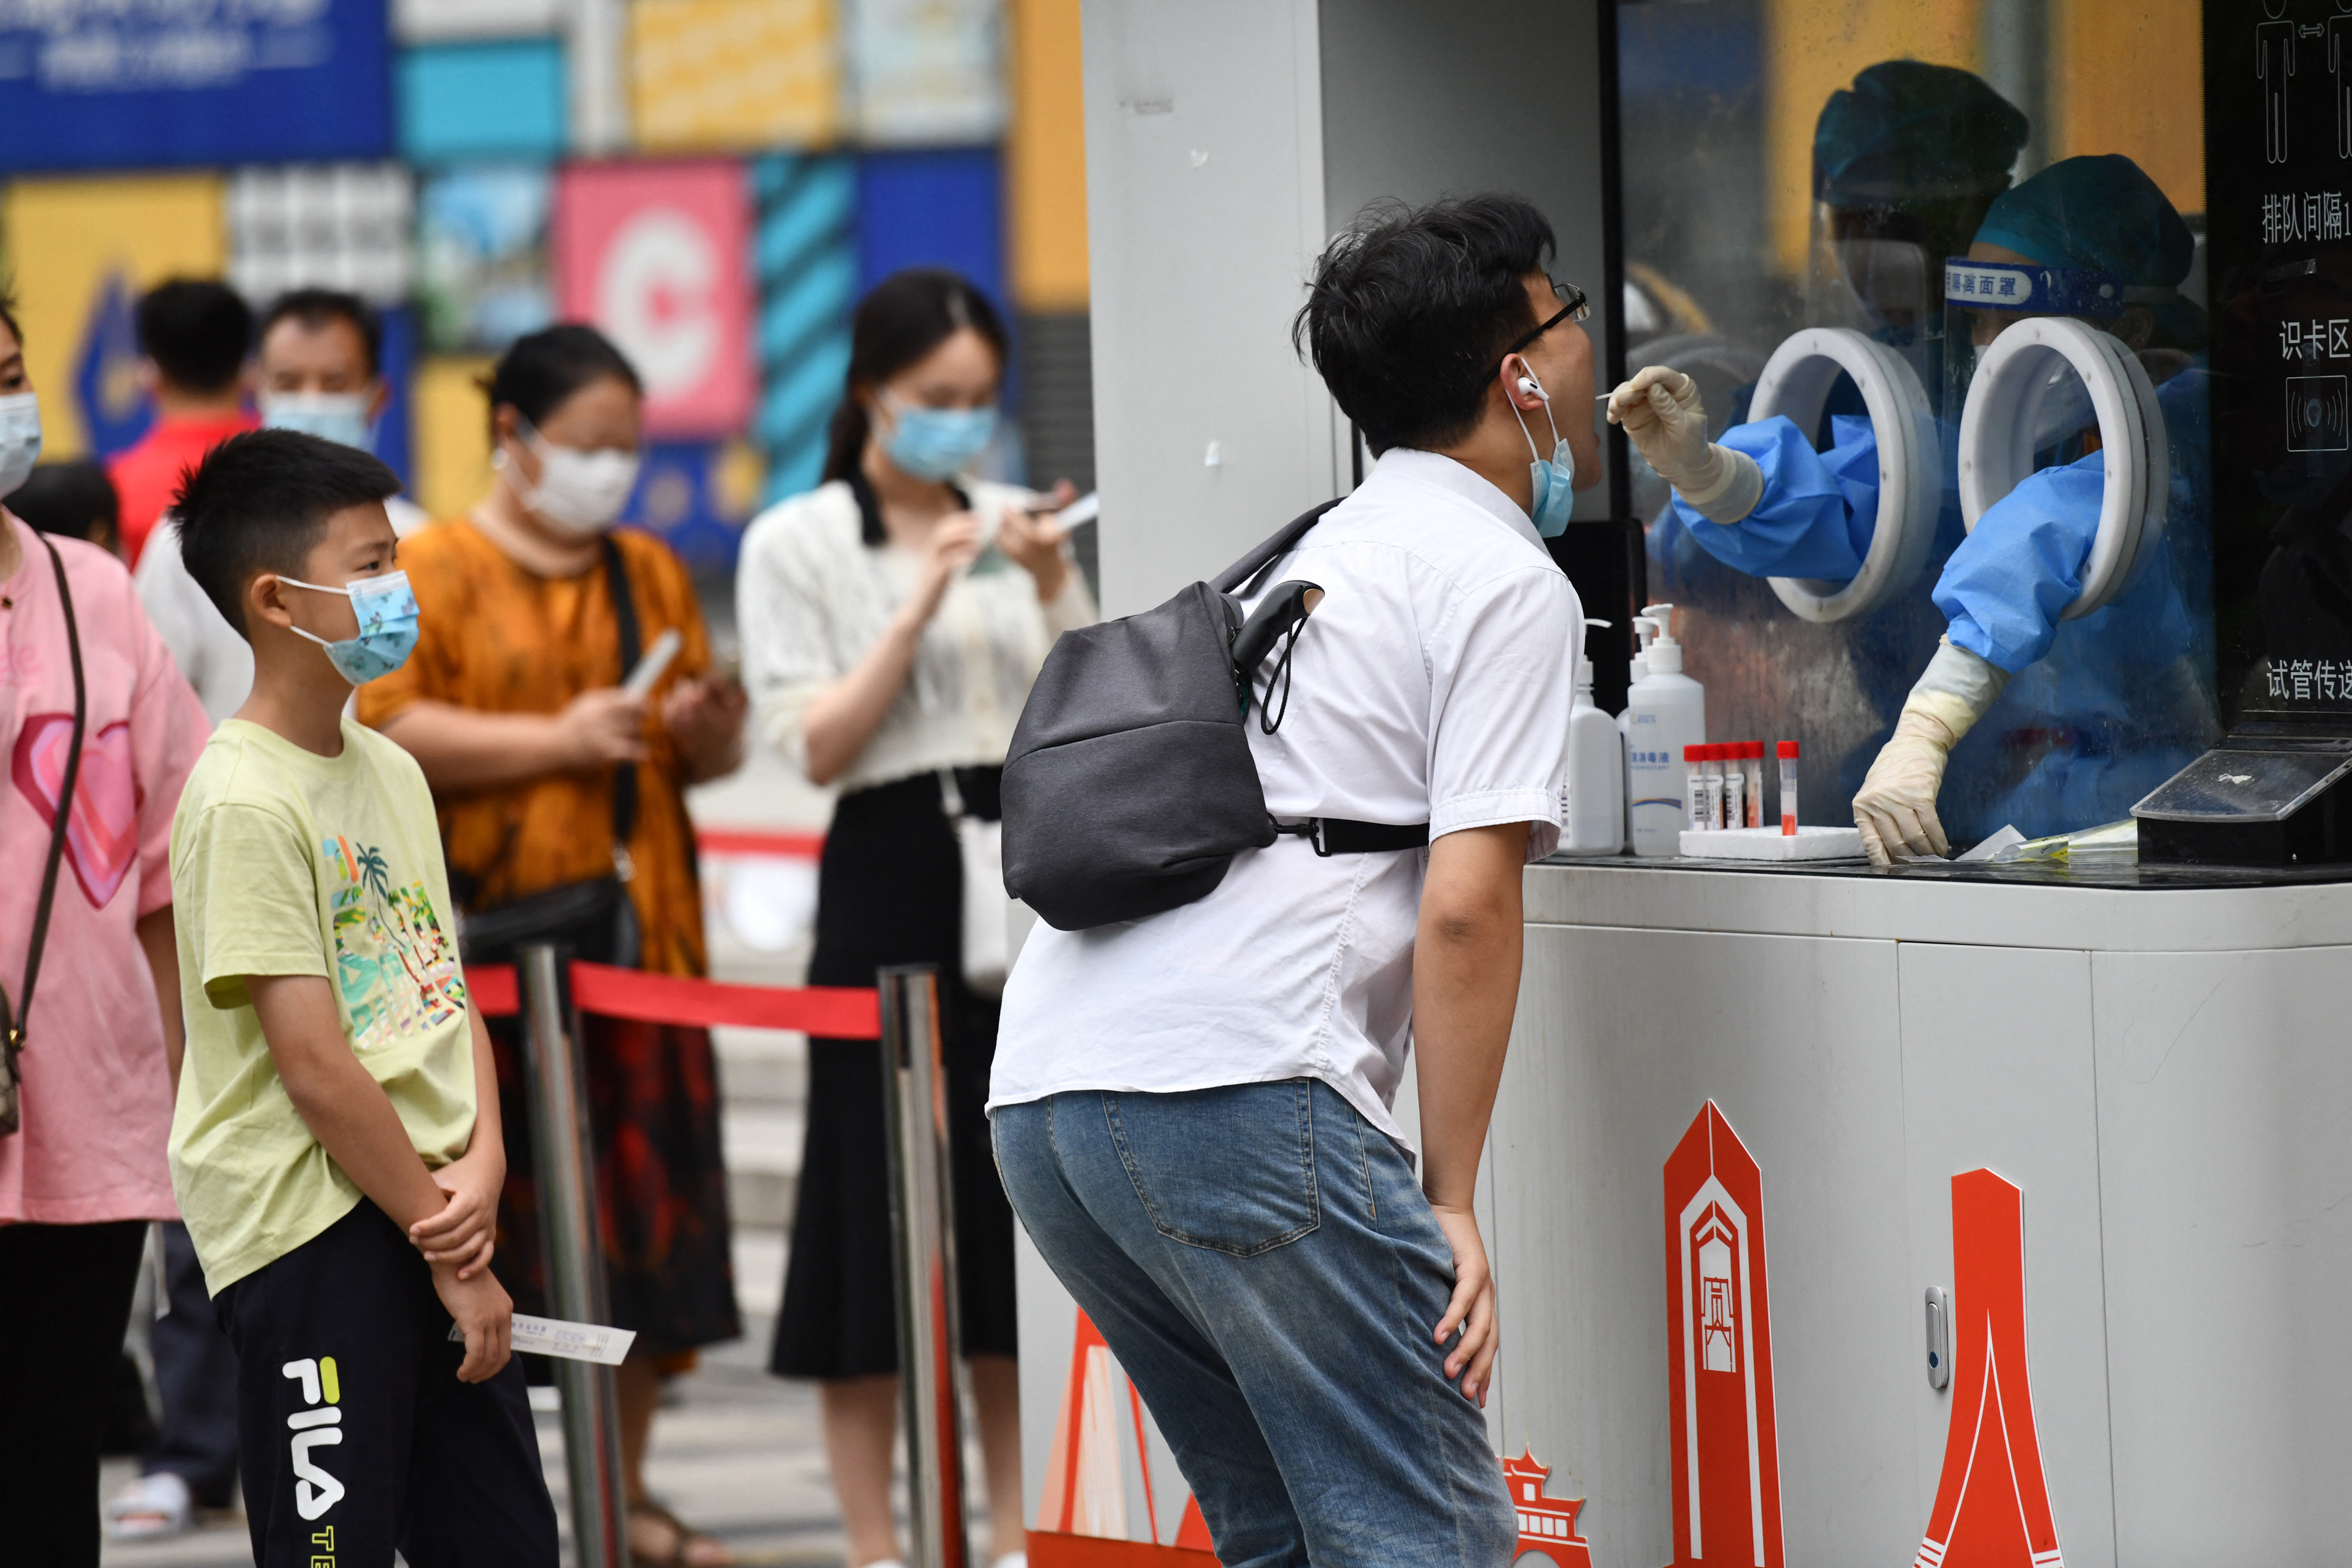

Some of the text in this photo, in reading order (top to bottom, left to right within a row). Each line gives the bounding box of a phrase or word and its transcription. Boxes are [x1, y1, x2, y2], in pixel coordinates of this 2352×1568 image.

[2279, 319, 2351, 360] 识卡区
[321, 835, 380, 1005] FILA
[282, 1356, 345, 1521] FILA
